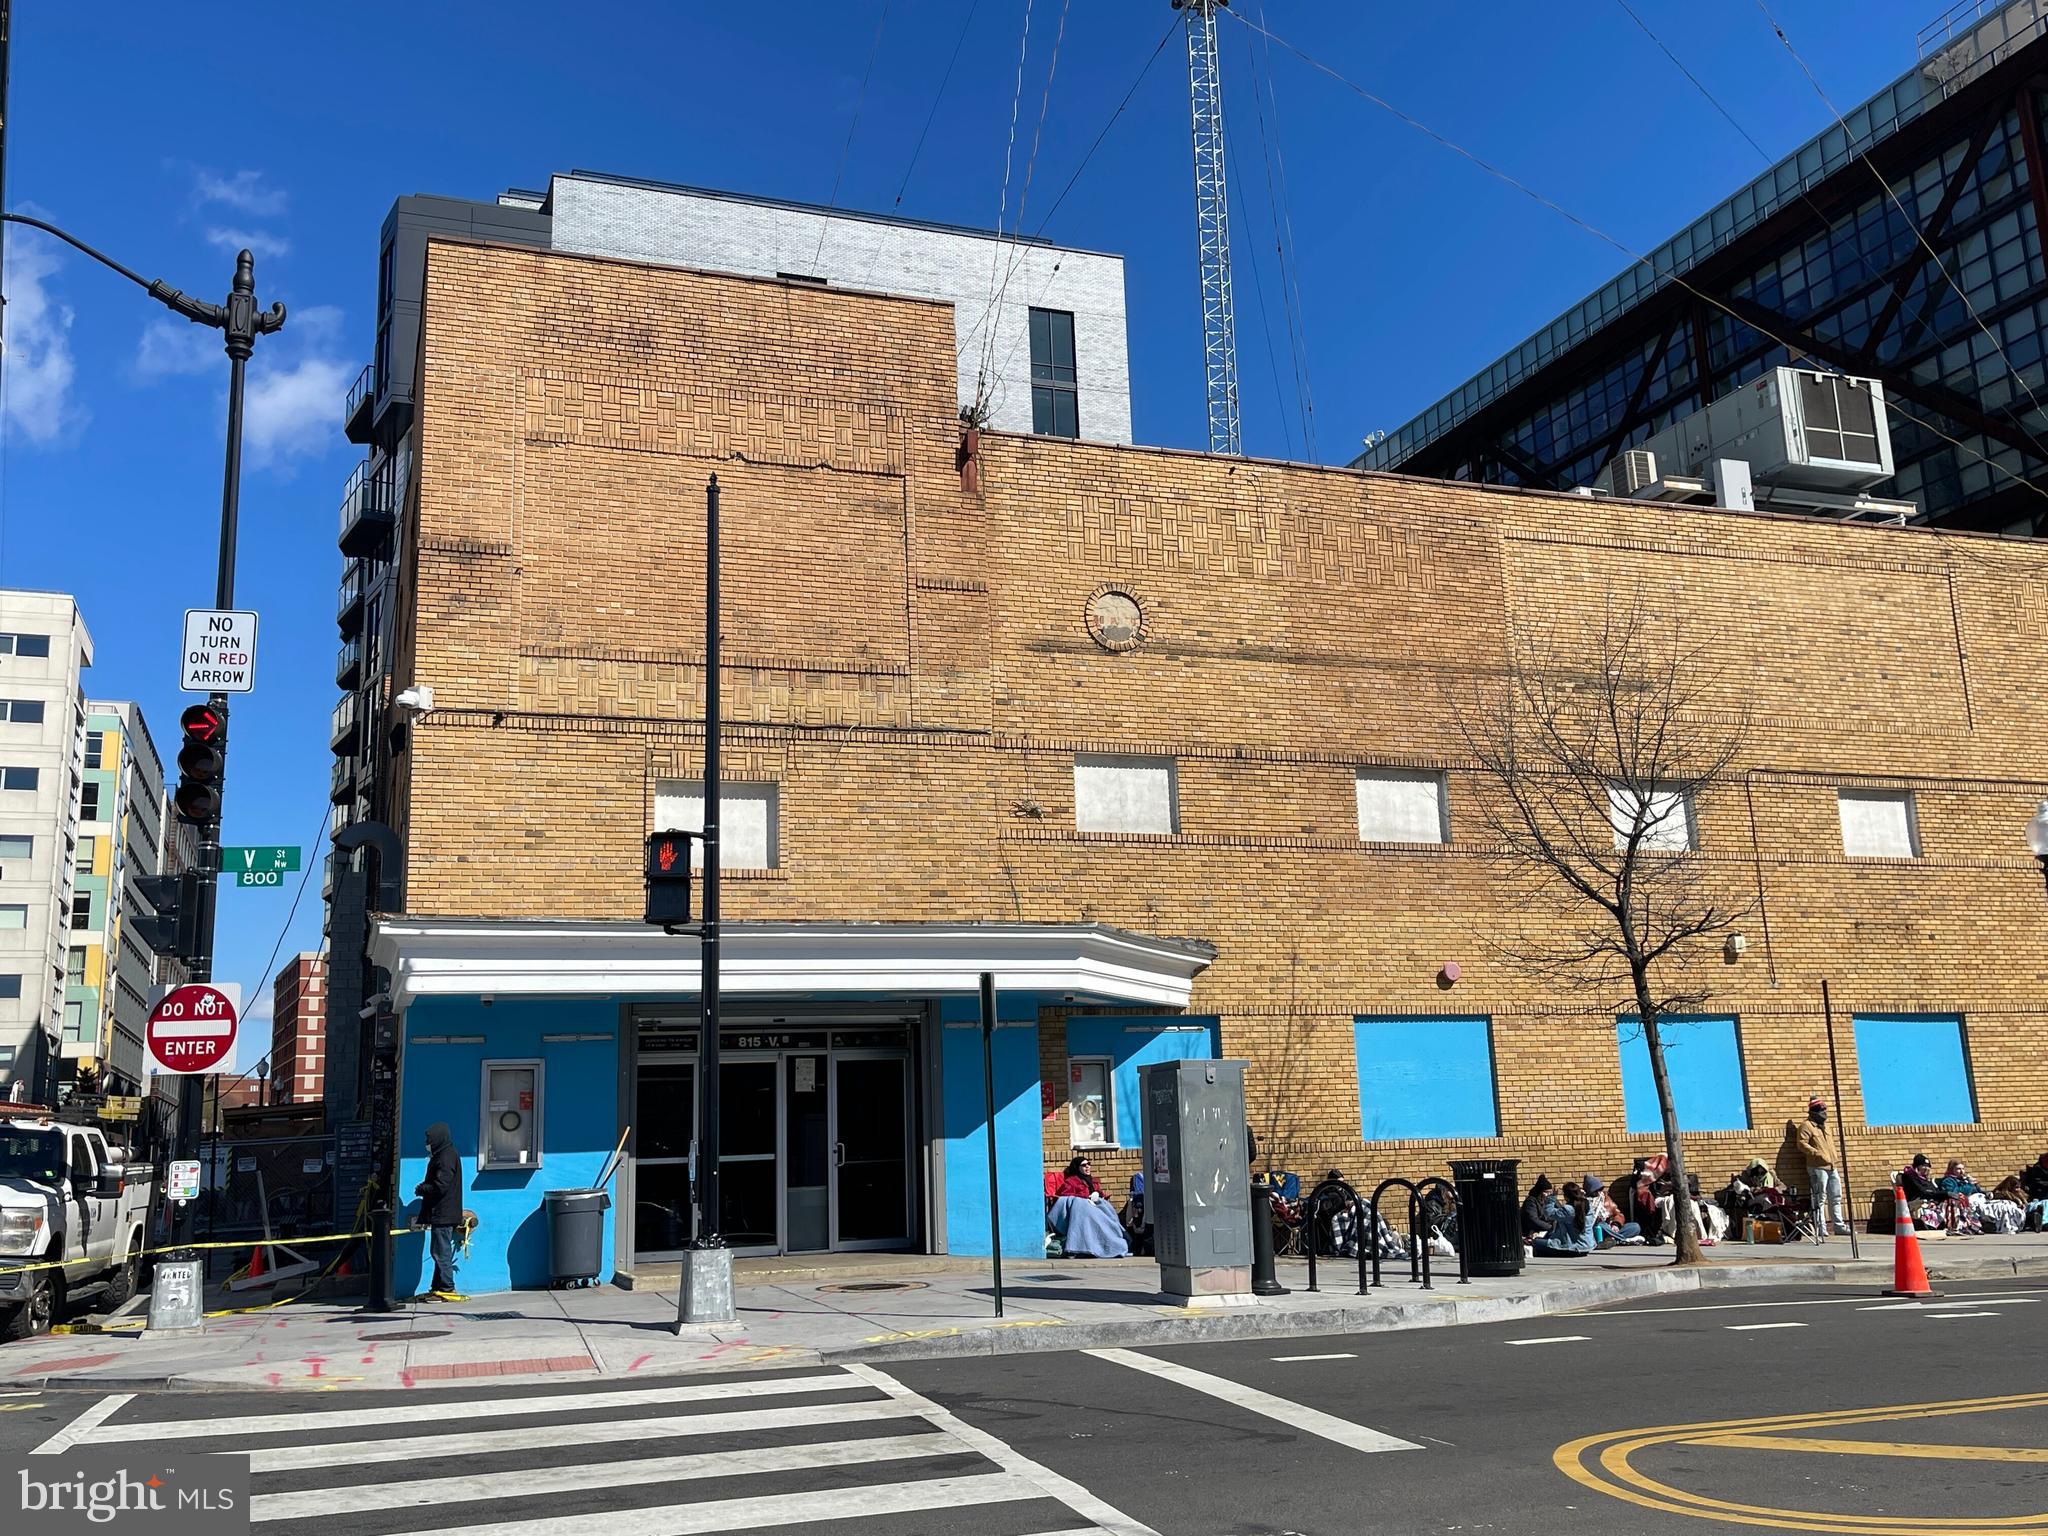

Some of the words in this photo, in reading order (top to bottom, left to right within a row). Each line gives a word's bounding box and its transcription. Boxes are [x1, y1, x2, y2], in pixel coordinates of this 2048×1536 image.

[209, 616, 233, 632] NO
[200, 635, 240, 648] TURN
[190, 651, 210, 664] ON
[219, 652, 248, 665] RED
[190, 669, 244, 683] ARROW
[244, 849, 256, 869] V
[276, 849, 286, 858] St
[243, 872, 277, 885] 800
[162, 1002, 184, 1017] DO
[194, 1001, 226, 1016] NOT
[165, 1040, 216, 1056] ENTER
[738, 1036, 761, 1047] 815
